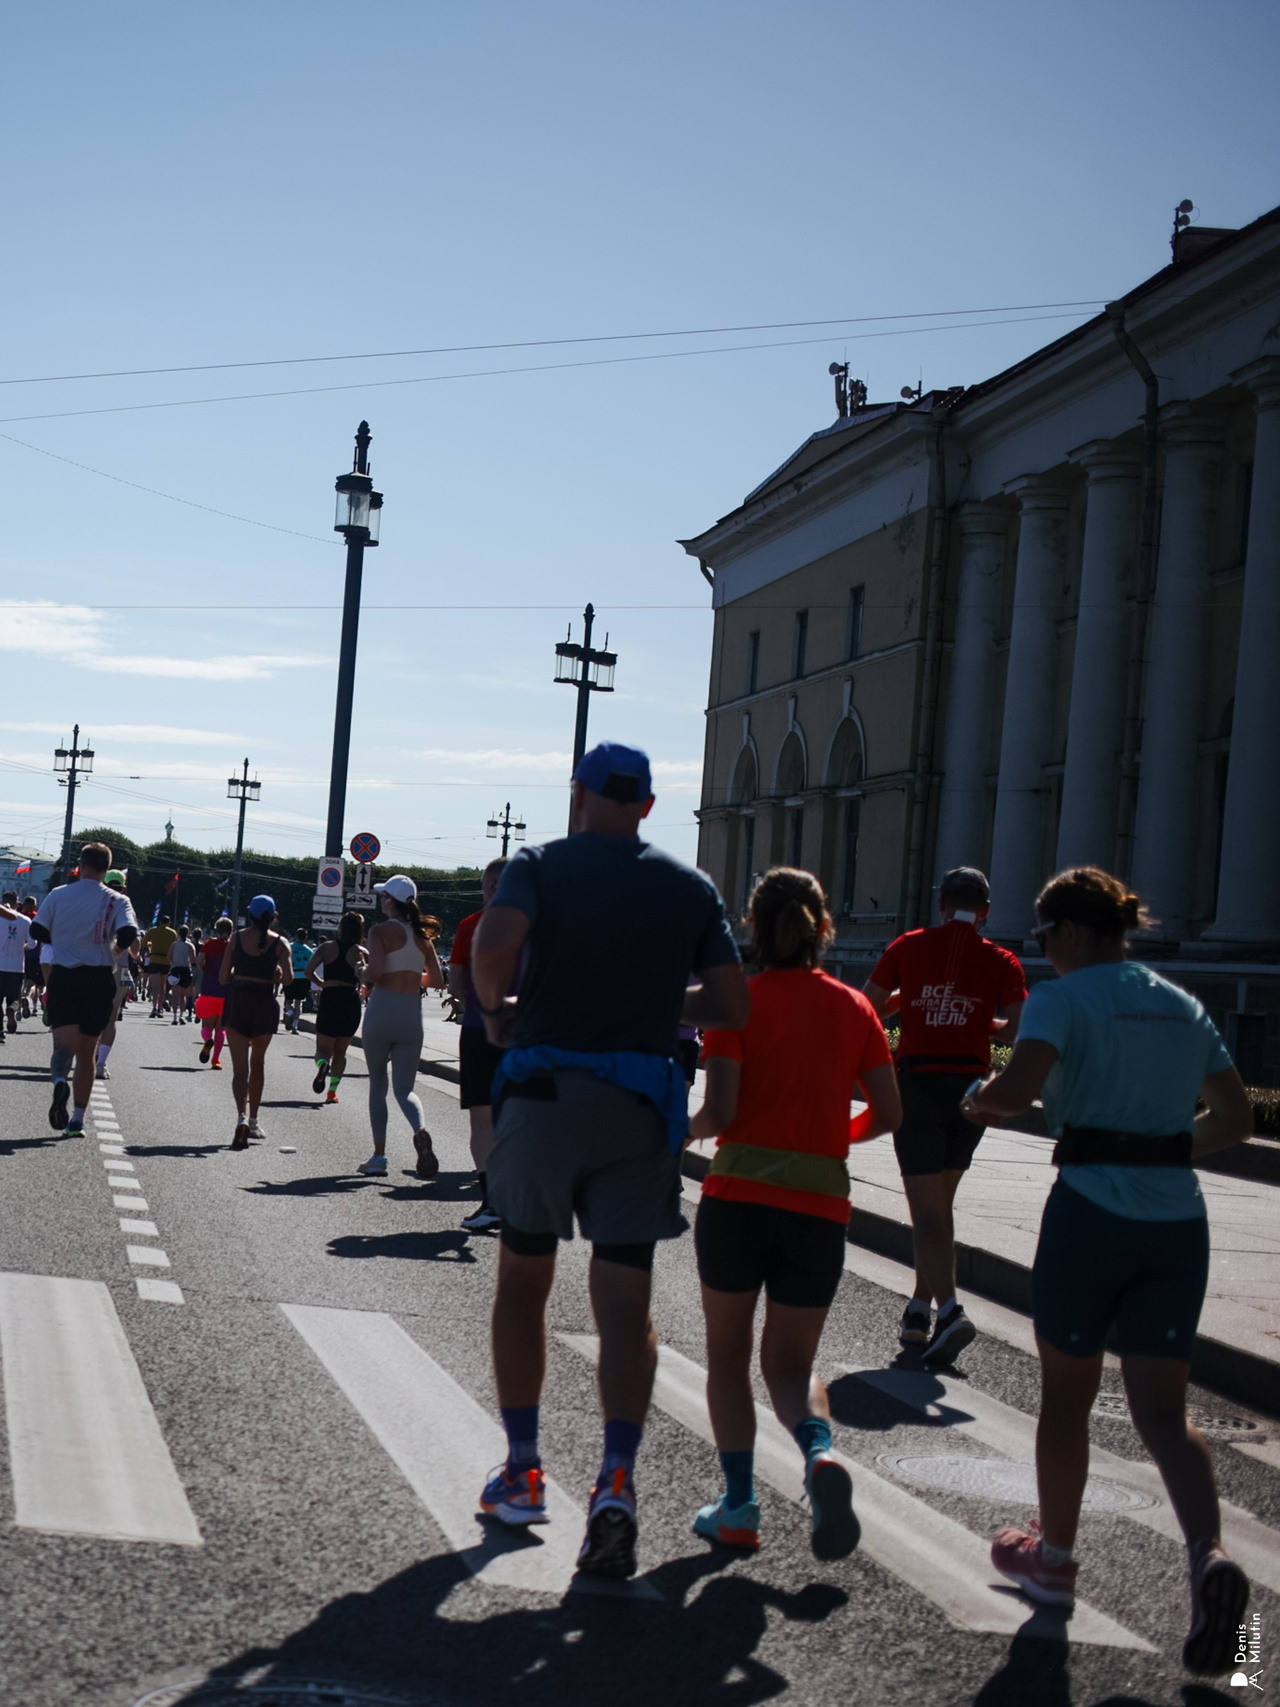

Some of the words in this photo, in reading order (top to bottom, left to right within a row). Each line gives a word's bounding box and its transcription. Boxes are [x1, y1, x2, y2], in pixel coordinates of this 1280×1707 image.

[921, 981, 955, 998] ВСЁ
[911, 998, 940, 1007] КОГДА
[940, 998, 975, 1013] ЕСТЬ
[926, 1011, 968, 1027] ЦЕЛЬ
